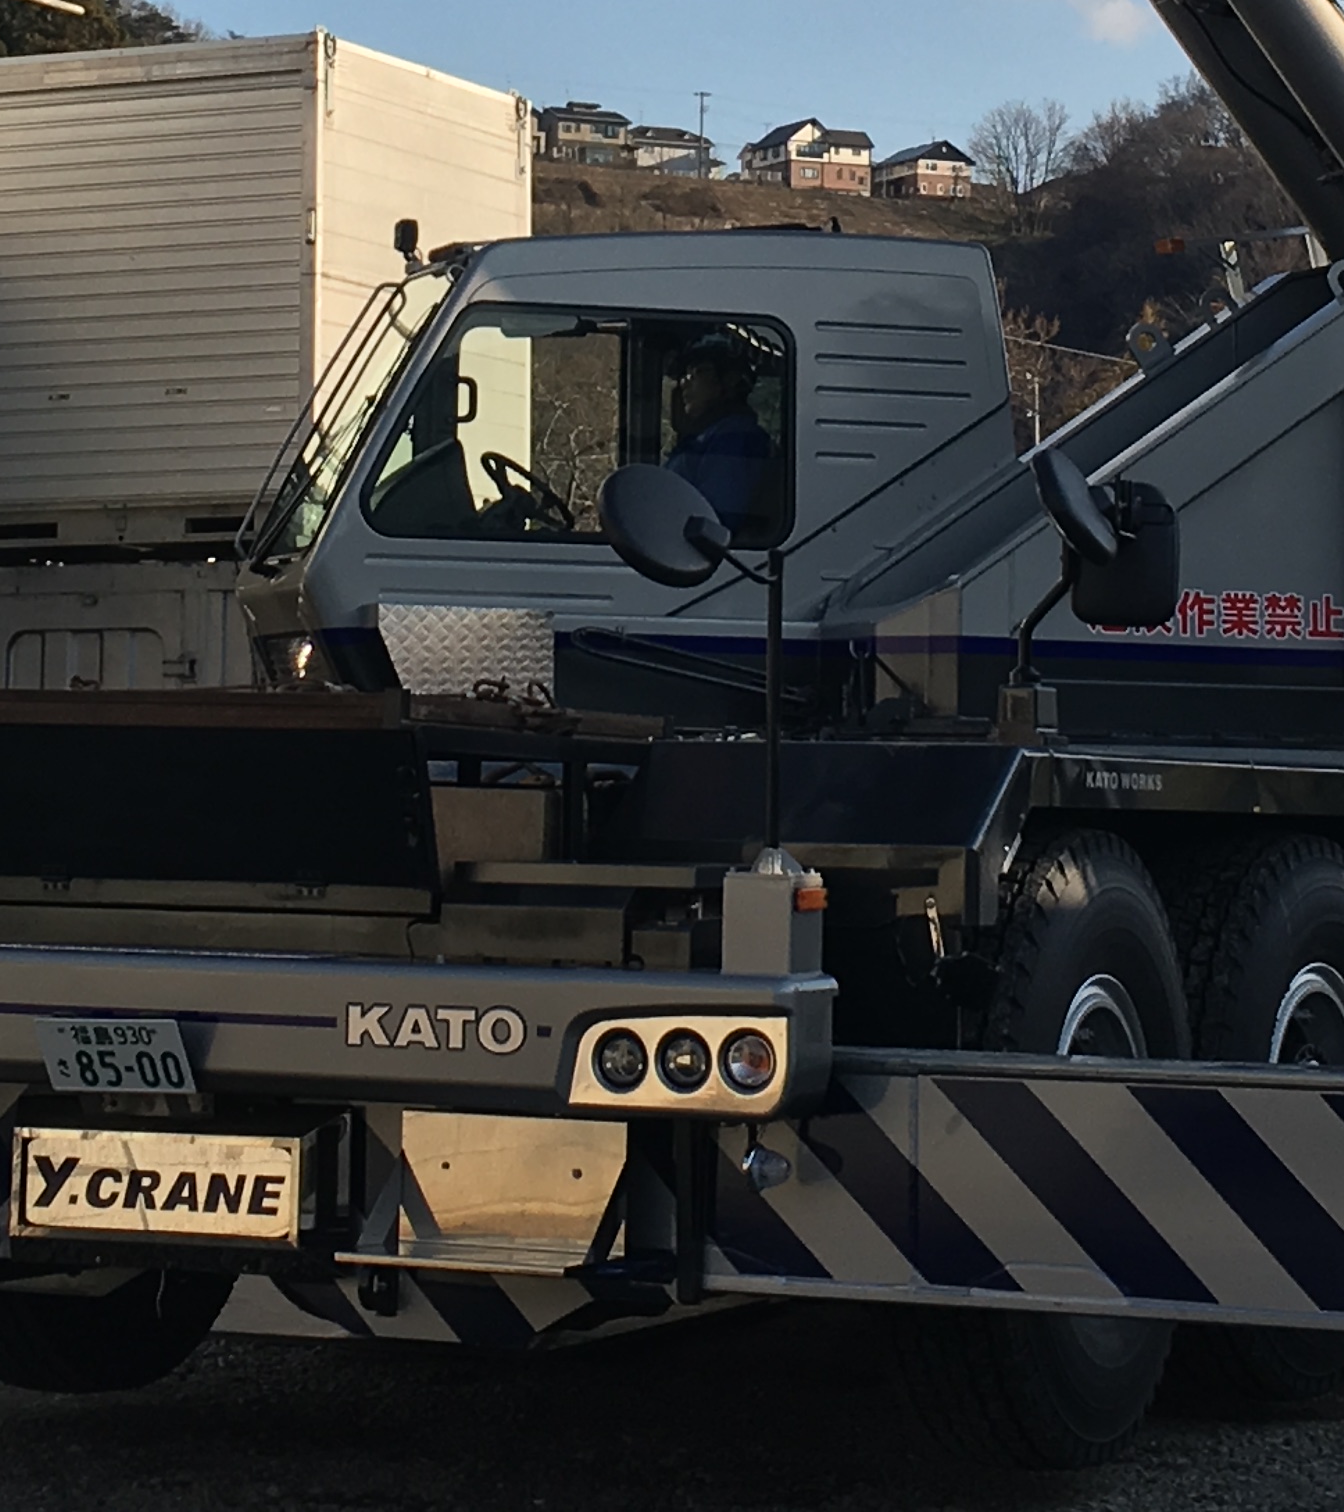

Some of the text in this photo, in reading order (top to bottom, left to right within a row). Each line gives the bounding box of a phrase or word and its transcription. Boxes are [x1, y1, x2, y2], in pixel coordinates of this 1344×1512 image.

[1086, 771, 1163, 791] KATO WORKS
[345, 1002, 528, 1056] KATO
[75, 1049, 186, 1088] 85-00
[32, 1154, 286, 1216] Y.CRANE
